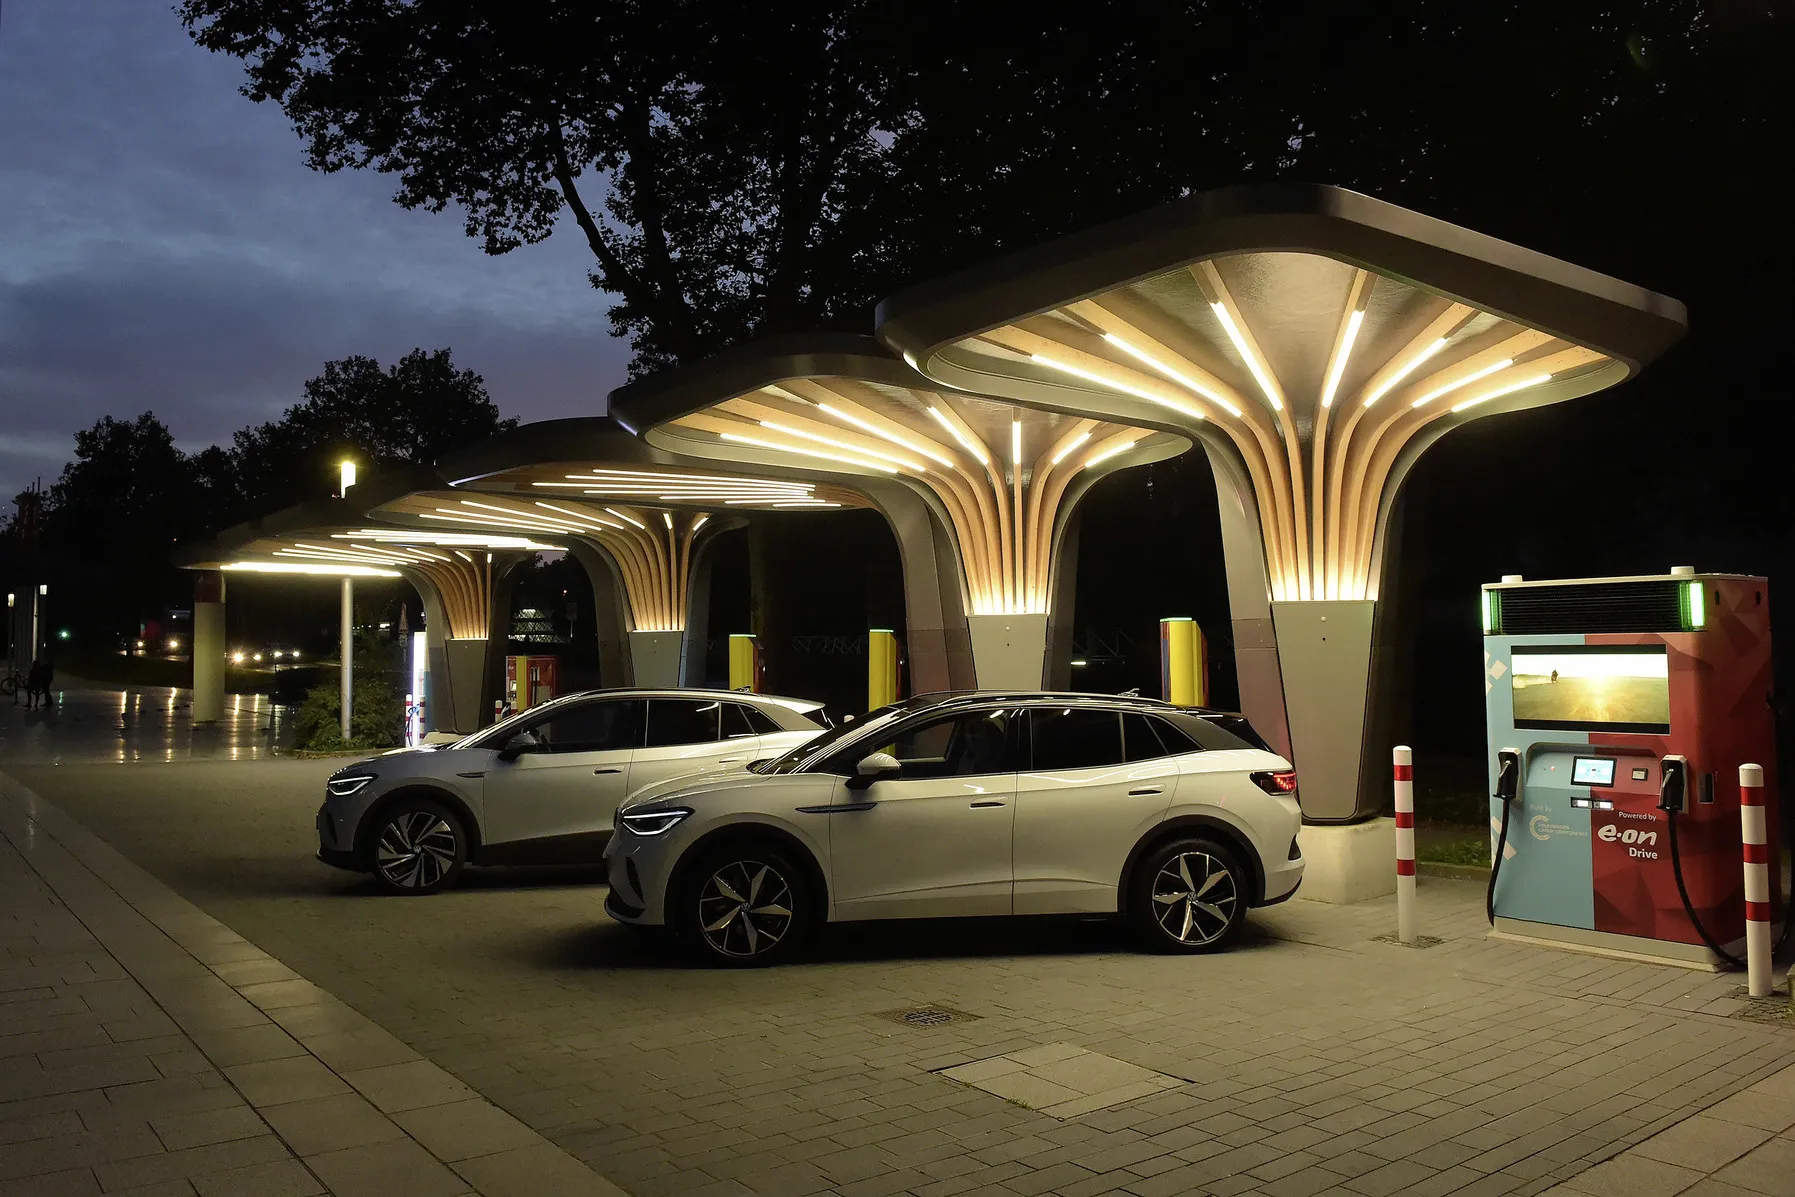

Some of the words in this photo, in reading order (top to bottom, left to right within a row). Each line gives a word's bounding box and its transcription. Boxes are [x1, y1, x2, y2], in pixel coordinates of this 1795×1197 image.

[1618, 811, 1647, 820] Powered
[1648, 814, 1656, 822] by
[1629, 847, 1658, 860] Drive
